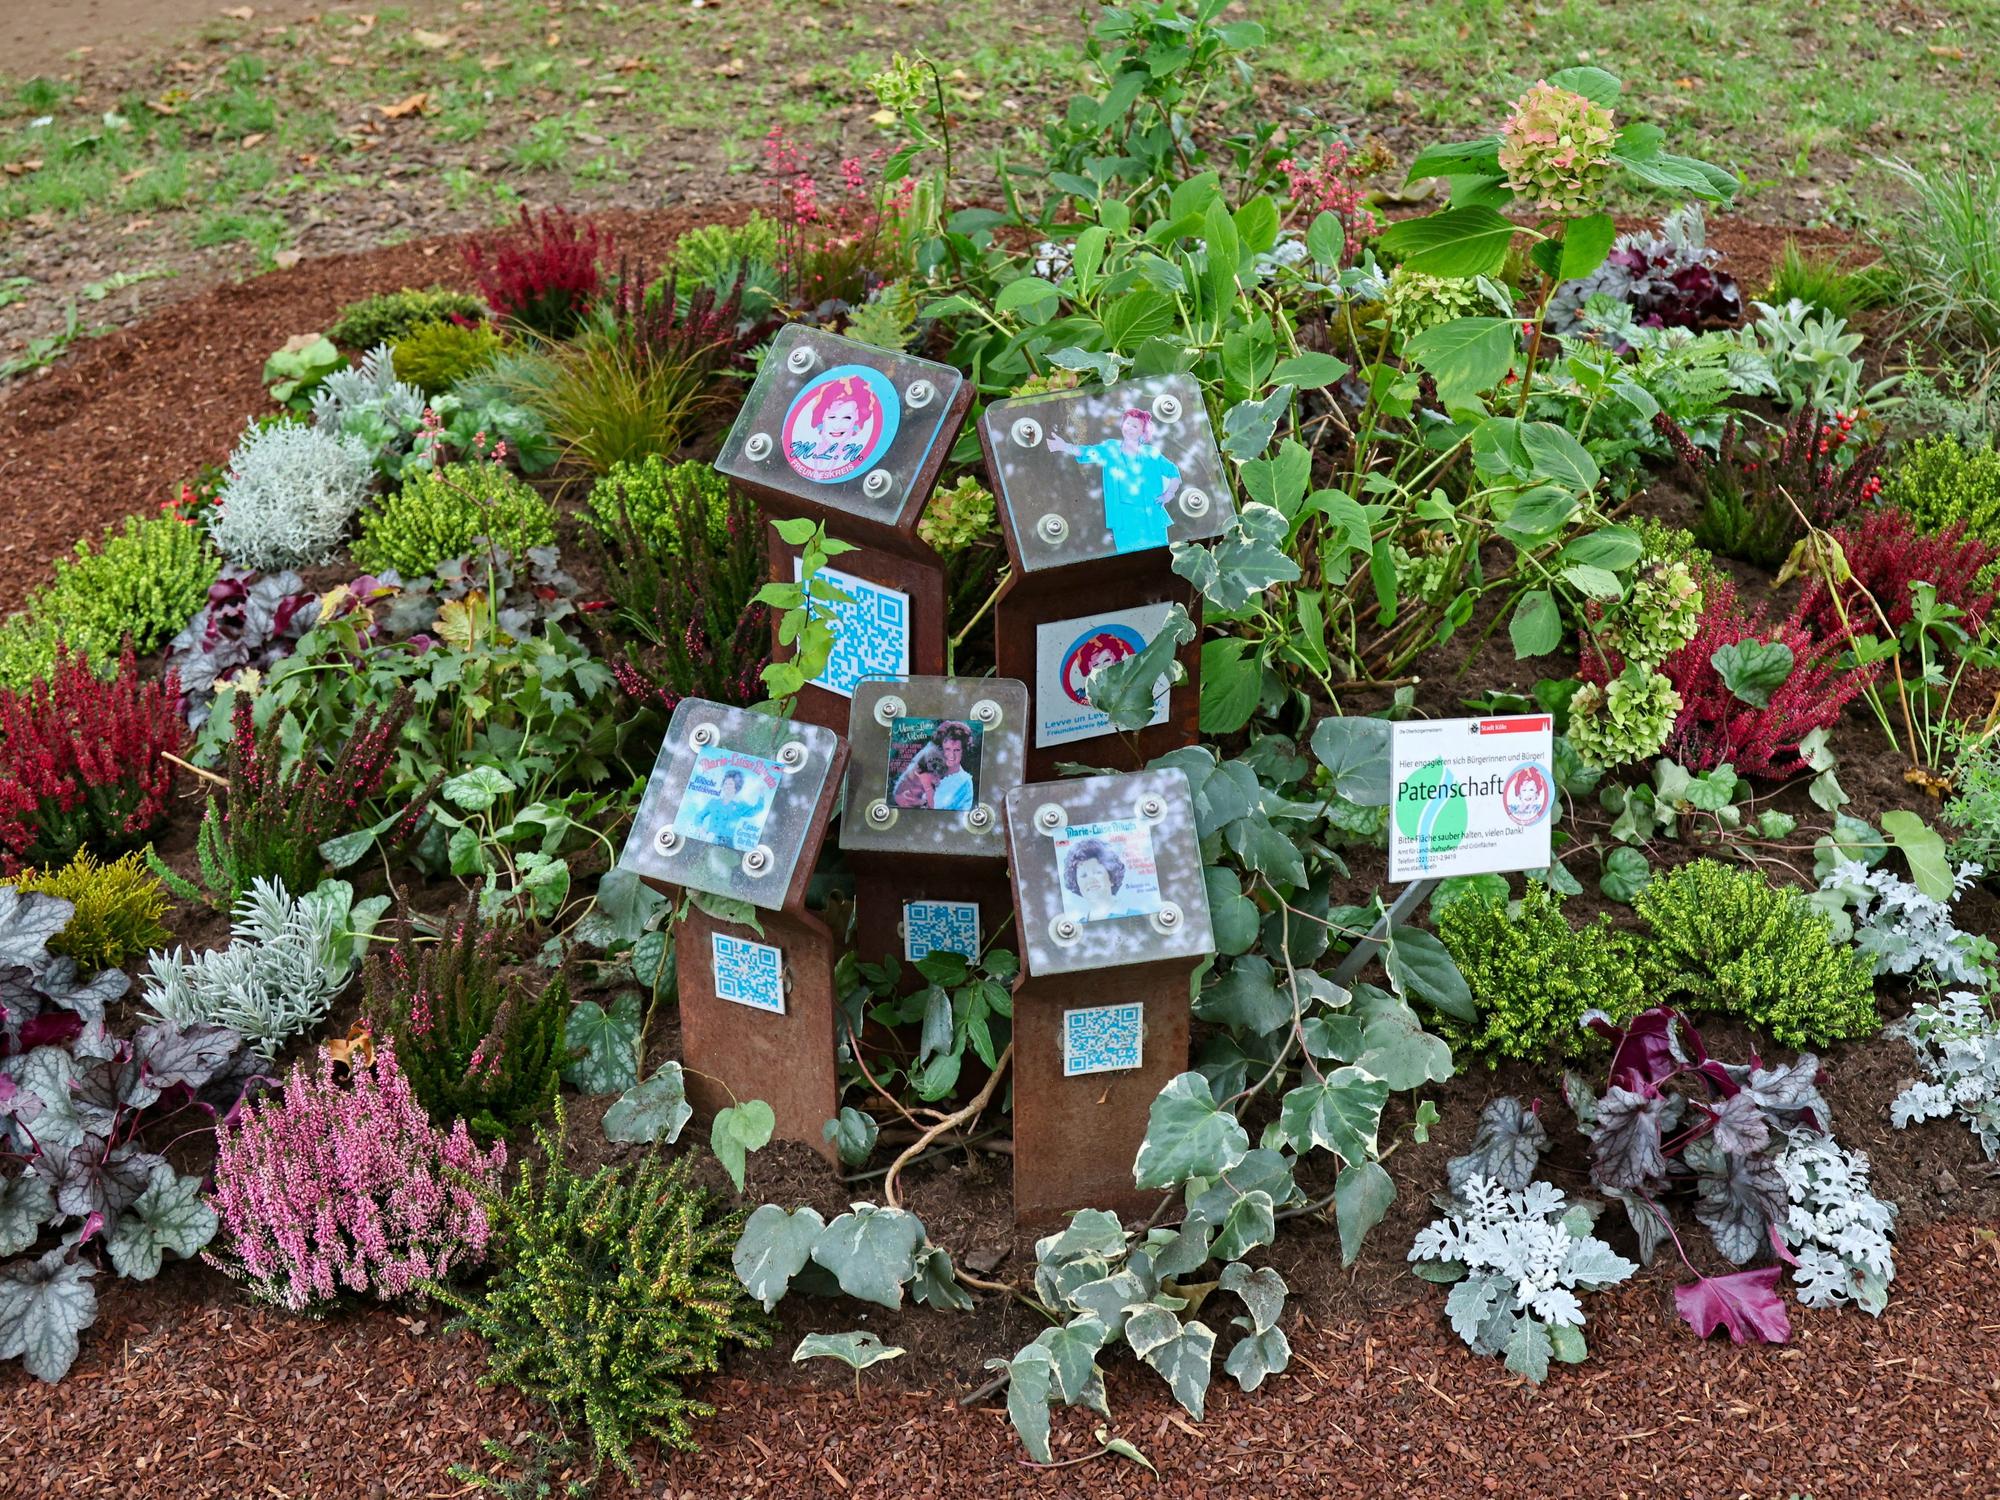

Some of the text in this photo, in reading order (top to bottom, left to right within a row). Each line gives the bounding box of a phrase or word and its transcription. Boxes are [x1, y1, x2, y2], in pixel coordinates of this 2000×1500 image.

[1046, 719, 1072, 729] Levve
[1047, 723, 1094, 736] Freundeskreis
[1495, 723, 1507, 731] Köln
[1399, 751, 1545, 770] Hier engagieren sich Bürgerinnen und Bürger!
[1398, 774, 1504, 801] Patenschaft
[1399, 826, 1524, 845] Bitte Fläche sauber halten, vielen Dank!
